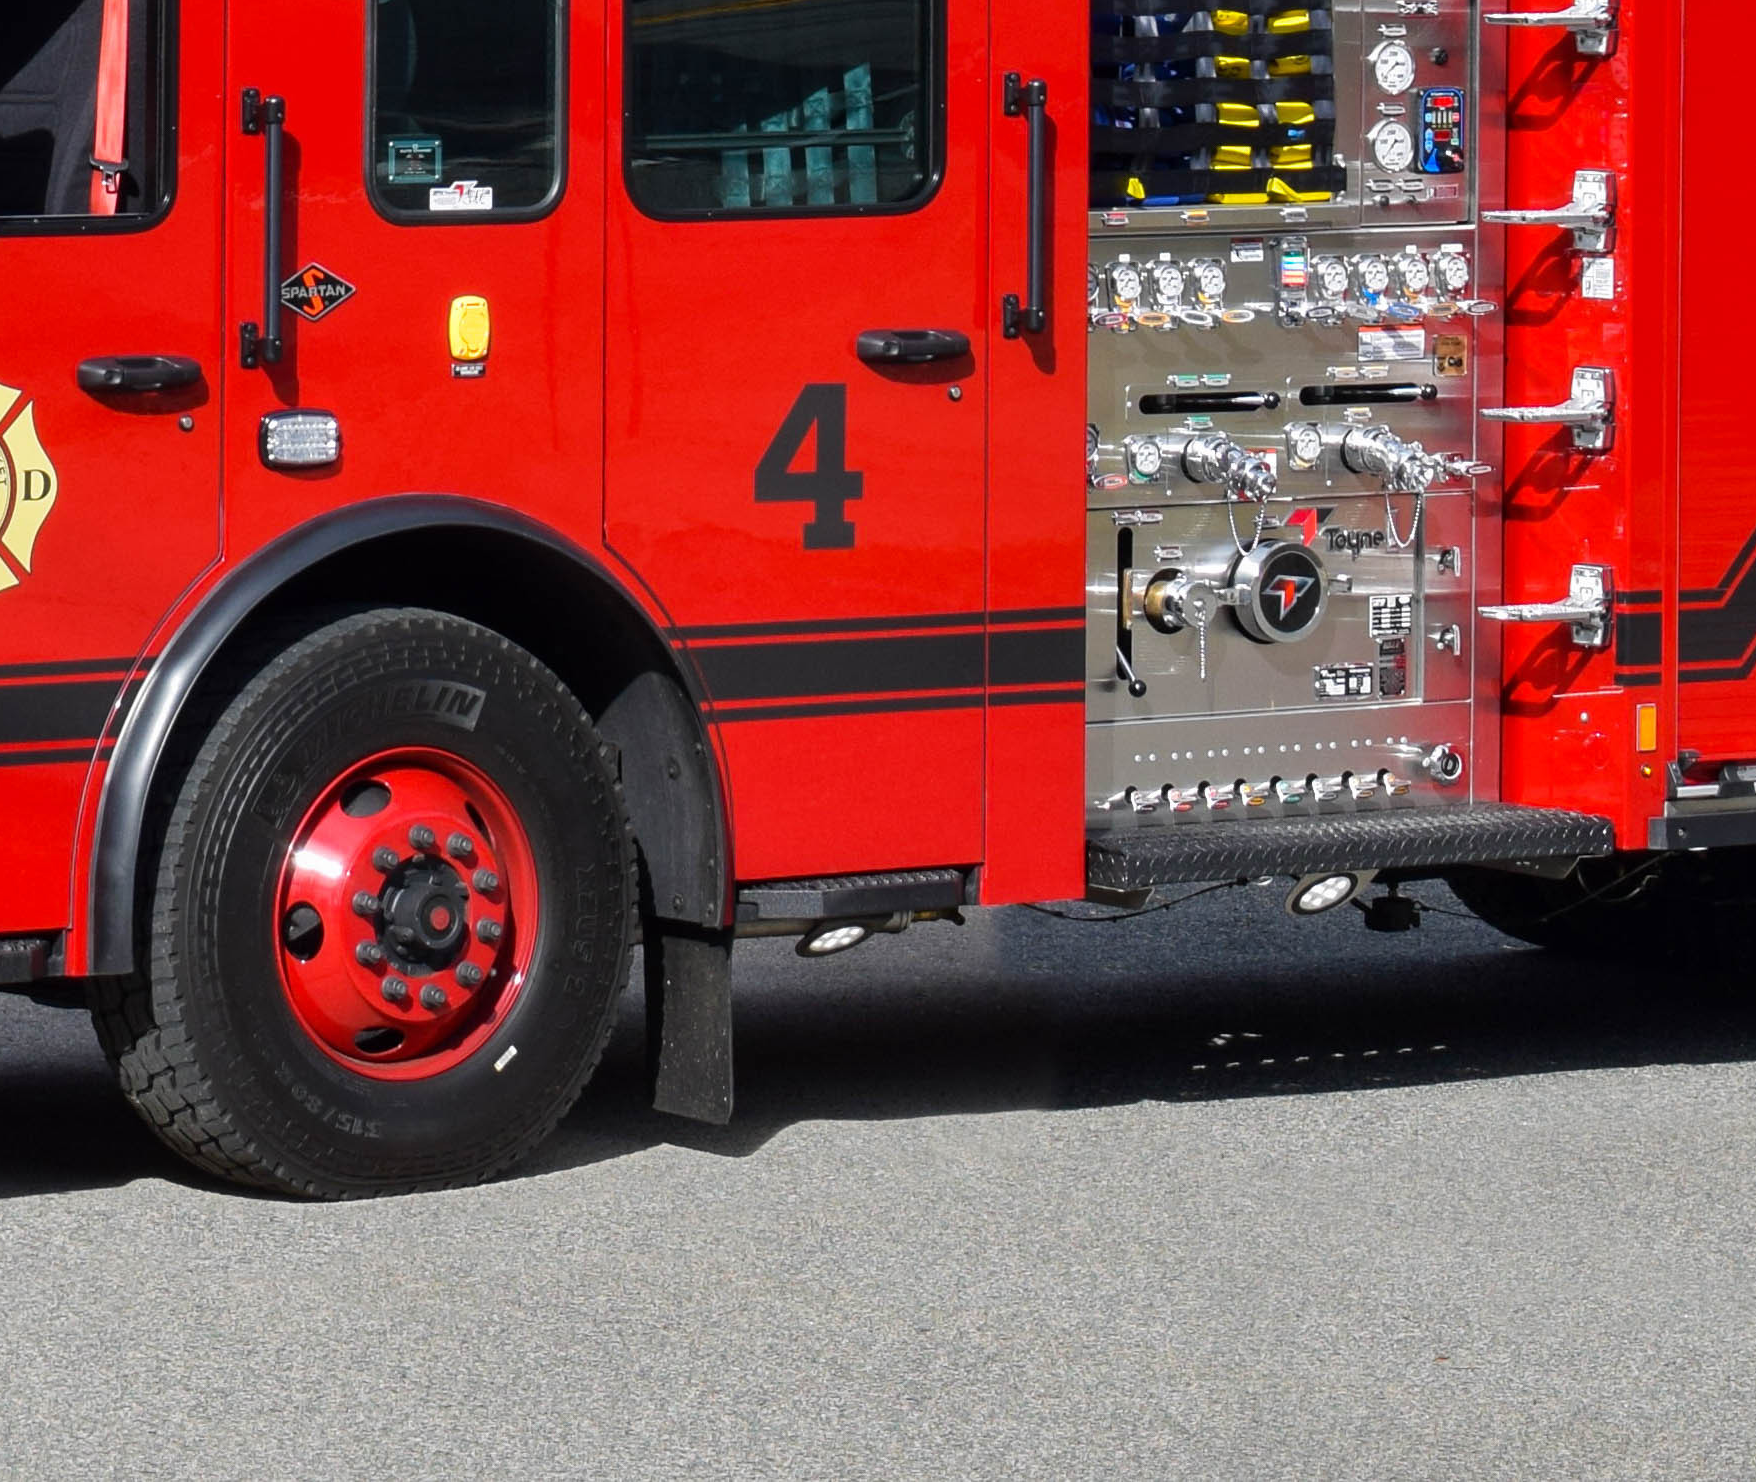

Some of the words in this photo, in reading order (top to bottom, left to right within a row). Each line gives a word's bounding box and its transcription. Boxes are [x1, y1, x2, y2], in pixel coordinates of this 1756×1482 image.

[281, 284, 346, 300] SPARTAN
[754, 383, 863, 550] 4
[21, 469, 52, 501] D
[1324, 527, 1385, 562] Toyne
